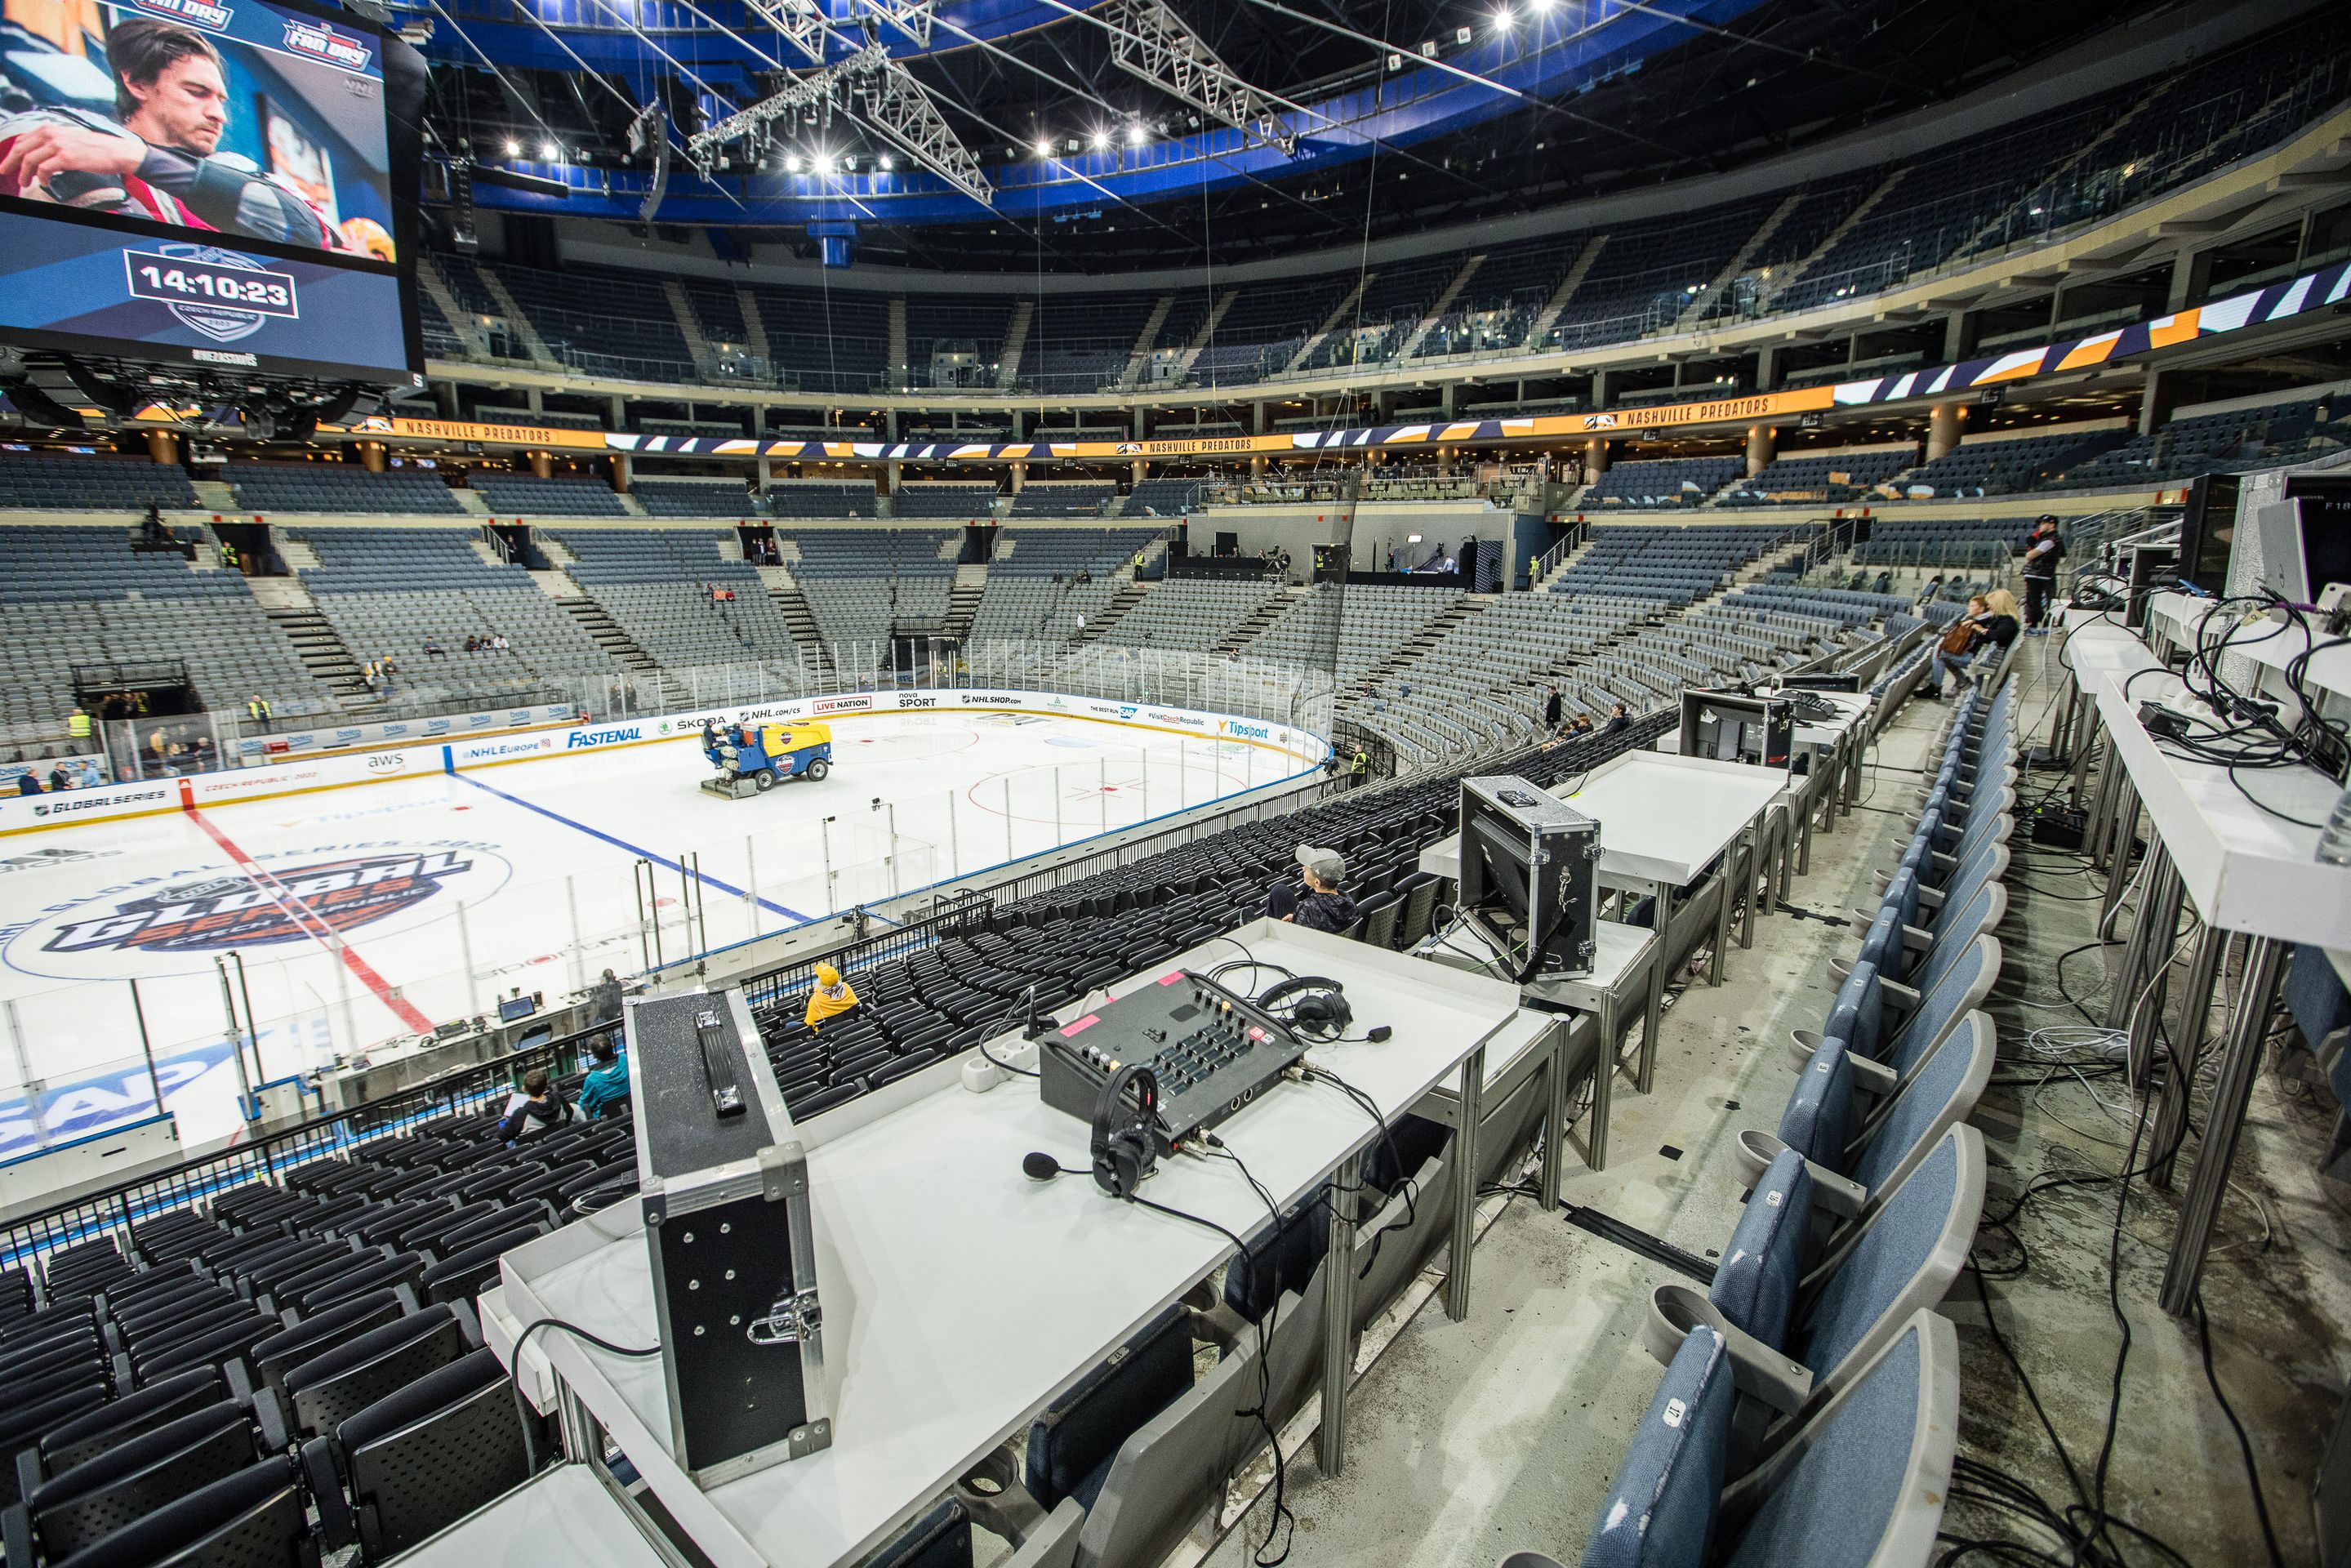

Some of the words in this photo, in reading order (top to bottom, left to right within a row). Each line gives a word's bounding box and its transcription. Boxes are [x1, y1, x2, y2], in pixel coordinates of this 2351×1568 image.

[140, 265, 289, 307] 14:10:23
[1627, 408, 1691, 425] NASHVILLE
[1701, 398, 1769, 419] PREDATORS
[407, 421, 475, 438] NASHVILLE
[484, 426, 550, 442] PREDATORS
[1150, 442, 1196, 453] NASHVILLE
[1202, 439, 1251, 451] PREDATORS
[837, 699, 868, 708] NATION
[899, 698, 937, 707] SPORT
[510, 710, 530, 718] beko
[548, 706, 568, 714] beko
[1120, 708, 1134, 717] SAP
[428, 719, 449, 728] beko
[470, 715, 491, 723] beko
[1148, 712, 1204, 726] #VisitCzechRepublic
[336, 728, 361, 738] beko
[383, 723, 407, 733] beko
[1229, 721, 1268, 739] Tipsport
[567, 727, 642, 748] FASTENAL
[368, 753, 404, 768] aws
[205, 782, 238, 792] CZECH
[241, 775, 288, 786] REPUBLIC
[253, 840, 402, 862] SERIES
[51, 852, 471, 949] GLOBAL
[165, 919, 272, 947] CZECH
[1668, 1405, 1681, 1419] 17
